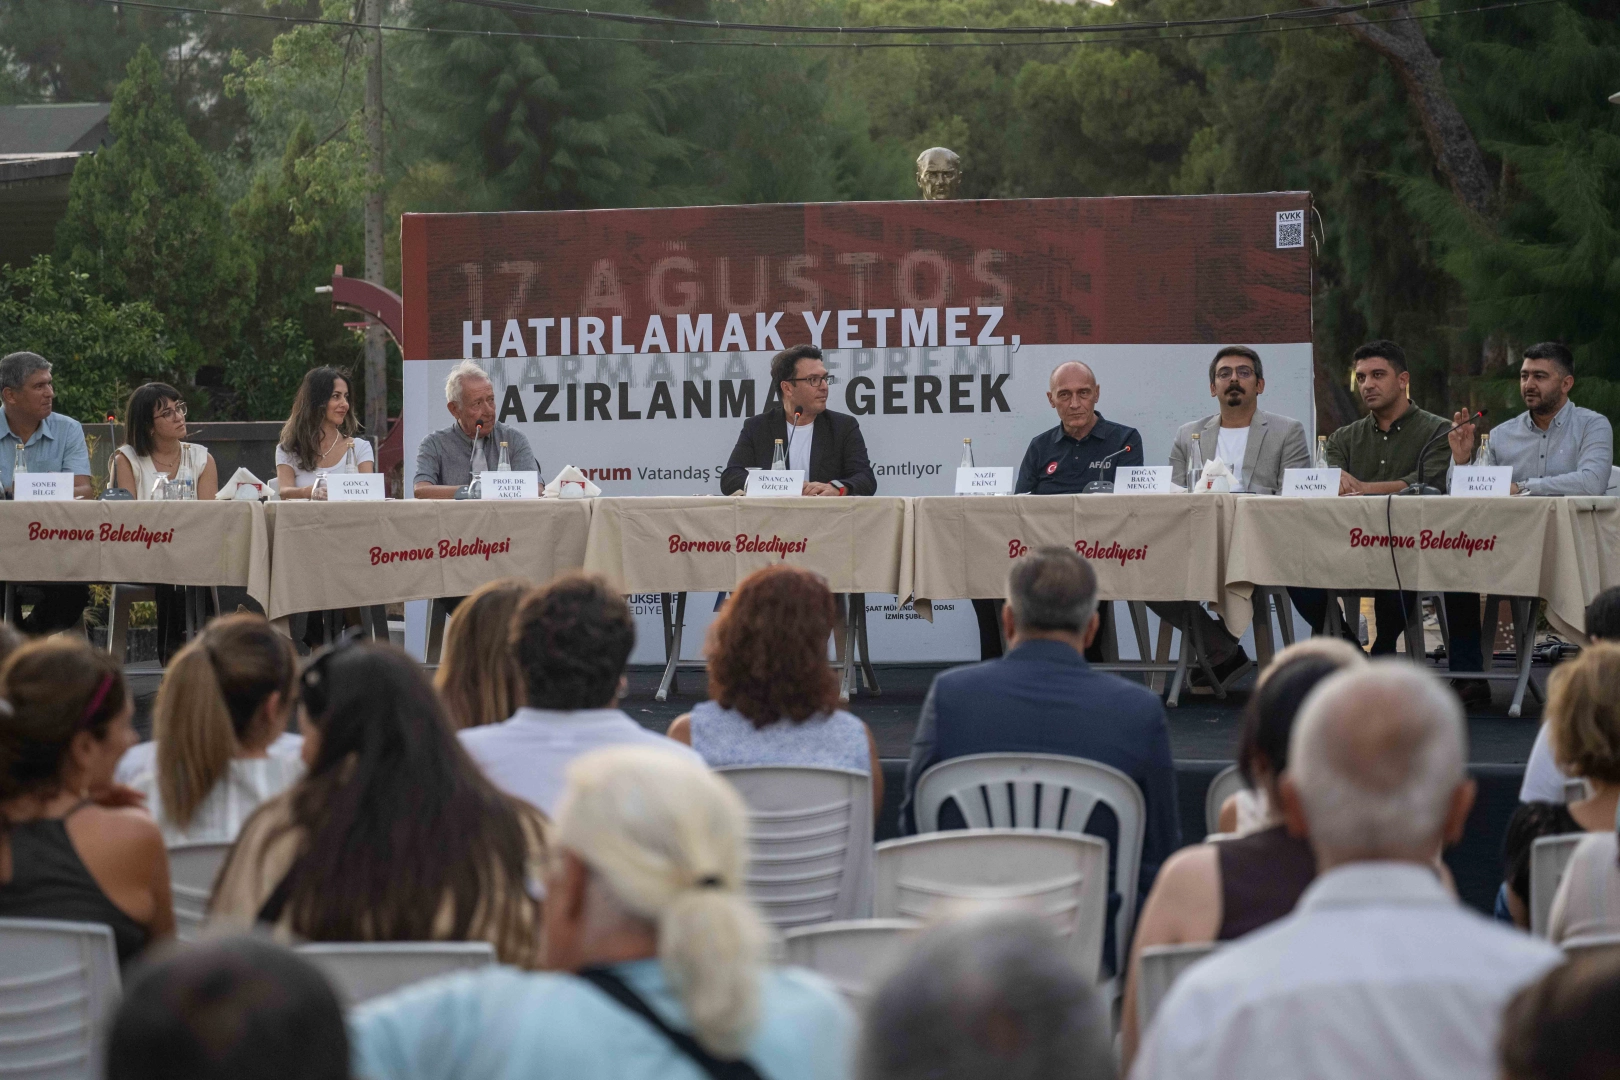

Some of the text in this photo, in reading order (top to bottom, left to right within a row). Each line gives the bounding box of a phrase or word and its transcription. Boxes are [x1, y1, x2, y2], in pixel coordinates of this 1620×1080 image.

[1279, 212, 1301, 220] KVKK
[455, 240, 1012, 322] 17 AĞUSTOS
[463, 306, 1021, 359] HATIRLAMAK YETMEZ,
[845, 373, 1012, 416] GEREK
[579, 466, 632, 481] orum
[637, 465, 710, 483] Vatandaş
[758, 475, 794, 483] SİNANCAN
[971, 479, 997, 487] EKİNCİ
[1477, 476, 1497, 484] ULAŞ
[32, 488, 56, 496] BİLGE
[761, 482, 789, 491] ÖZİÇER
[28, 521, 175, 550] Bornova Belediyesi
[668, 533, 808, 559] Bornova Belediyesi
[1349, 527, 1497, 558] Bornova Belediyesi
[369, 537, 511, 566] Bornova Belediyesi
[1074, 539, 1148, 567] Belediyesi
[885, 612, 904, 620] İZMİR
